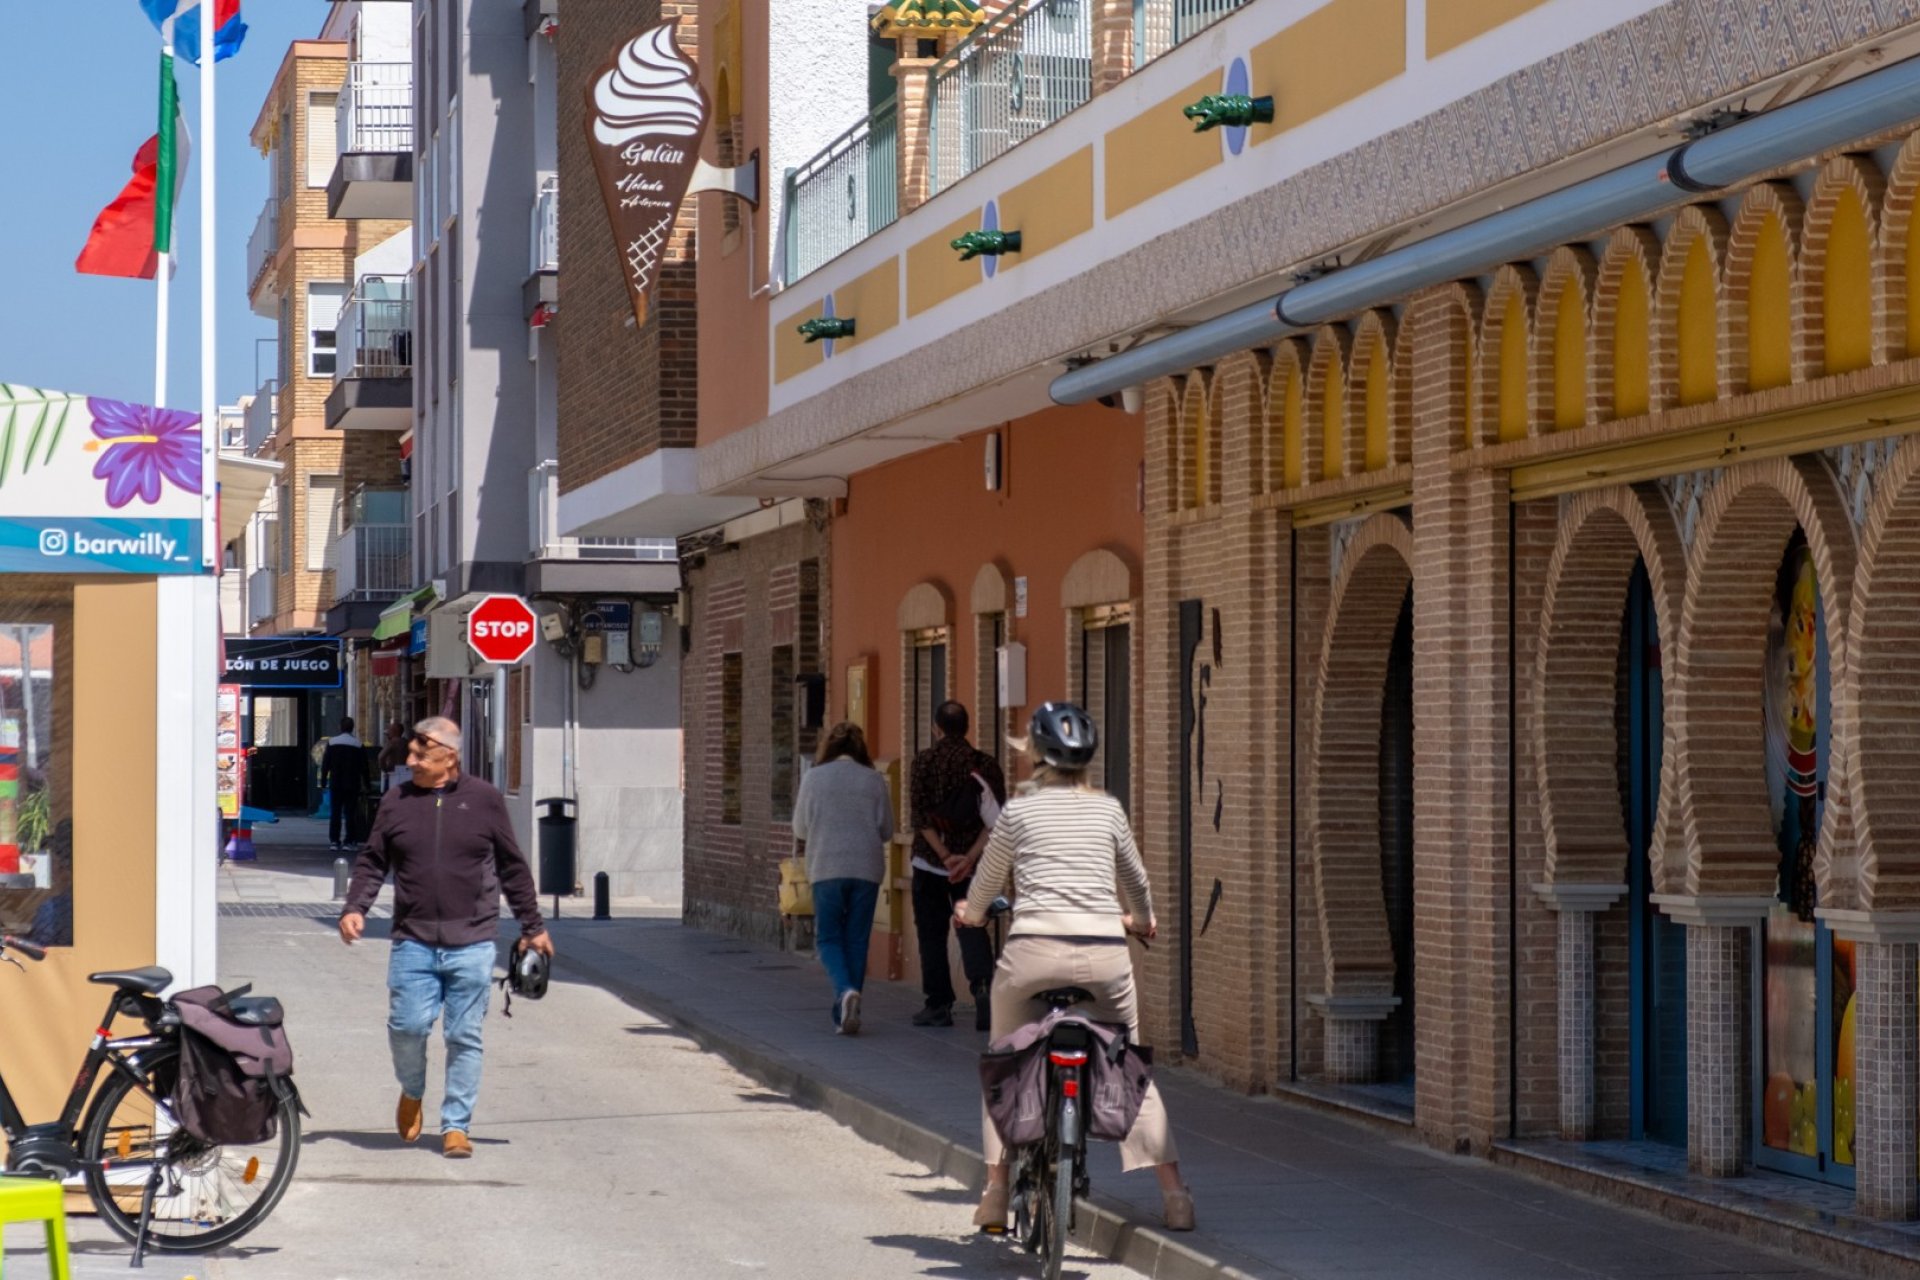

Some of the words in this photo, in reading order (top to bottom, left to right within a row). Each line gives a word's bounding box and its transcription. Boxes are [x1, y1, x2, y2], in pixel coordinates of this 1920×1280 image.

[474, 620, 530, 637] STOP
[226, 656, 254, 670] LÓN
[260, 660, 278, 670] DE
[284, 660, 330, 670] JUEGO
